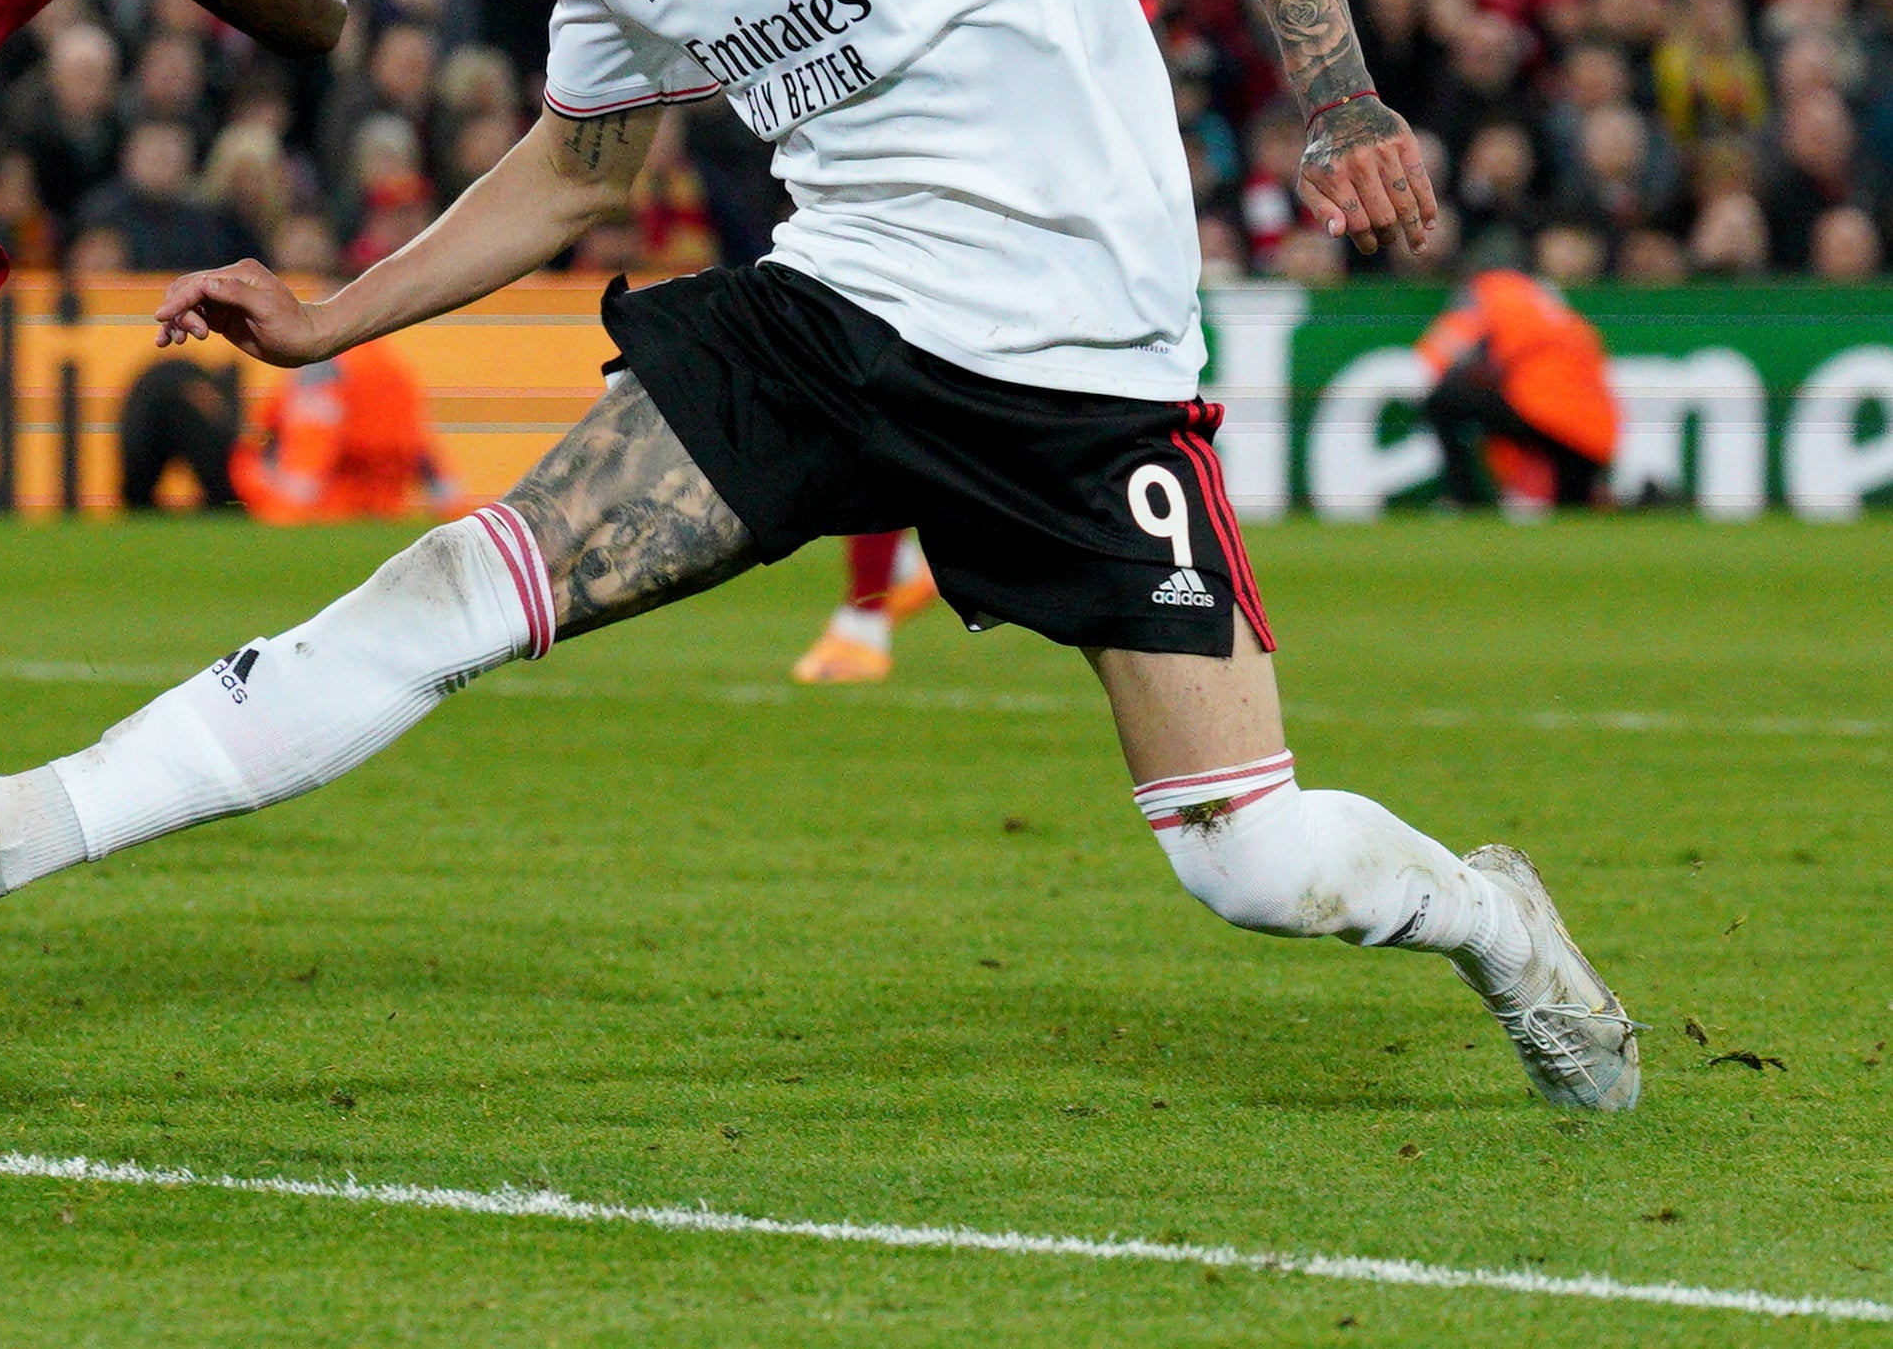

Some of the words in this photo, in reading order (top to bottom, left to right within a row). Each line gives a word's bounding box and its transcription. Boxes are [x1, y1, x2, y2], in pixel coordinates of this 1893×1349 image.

[744, 81, 780, 136] FLY
[783, 44, 877, 121] BETTER
[1127, 464, 1194, 568] 9
[1151, 590, 1215, 608] adidas
